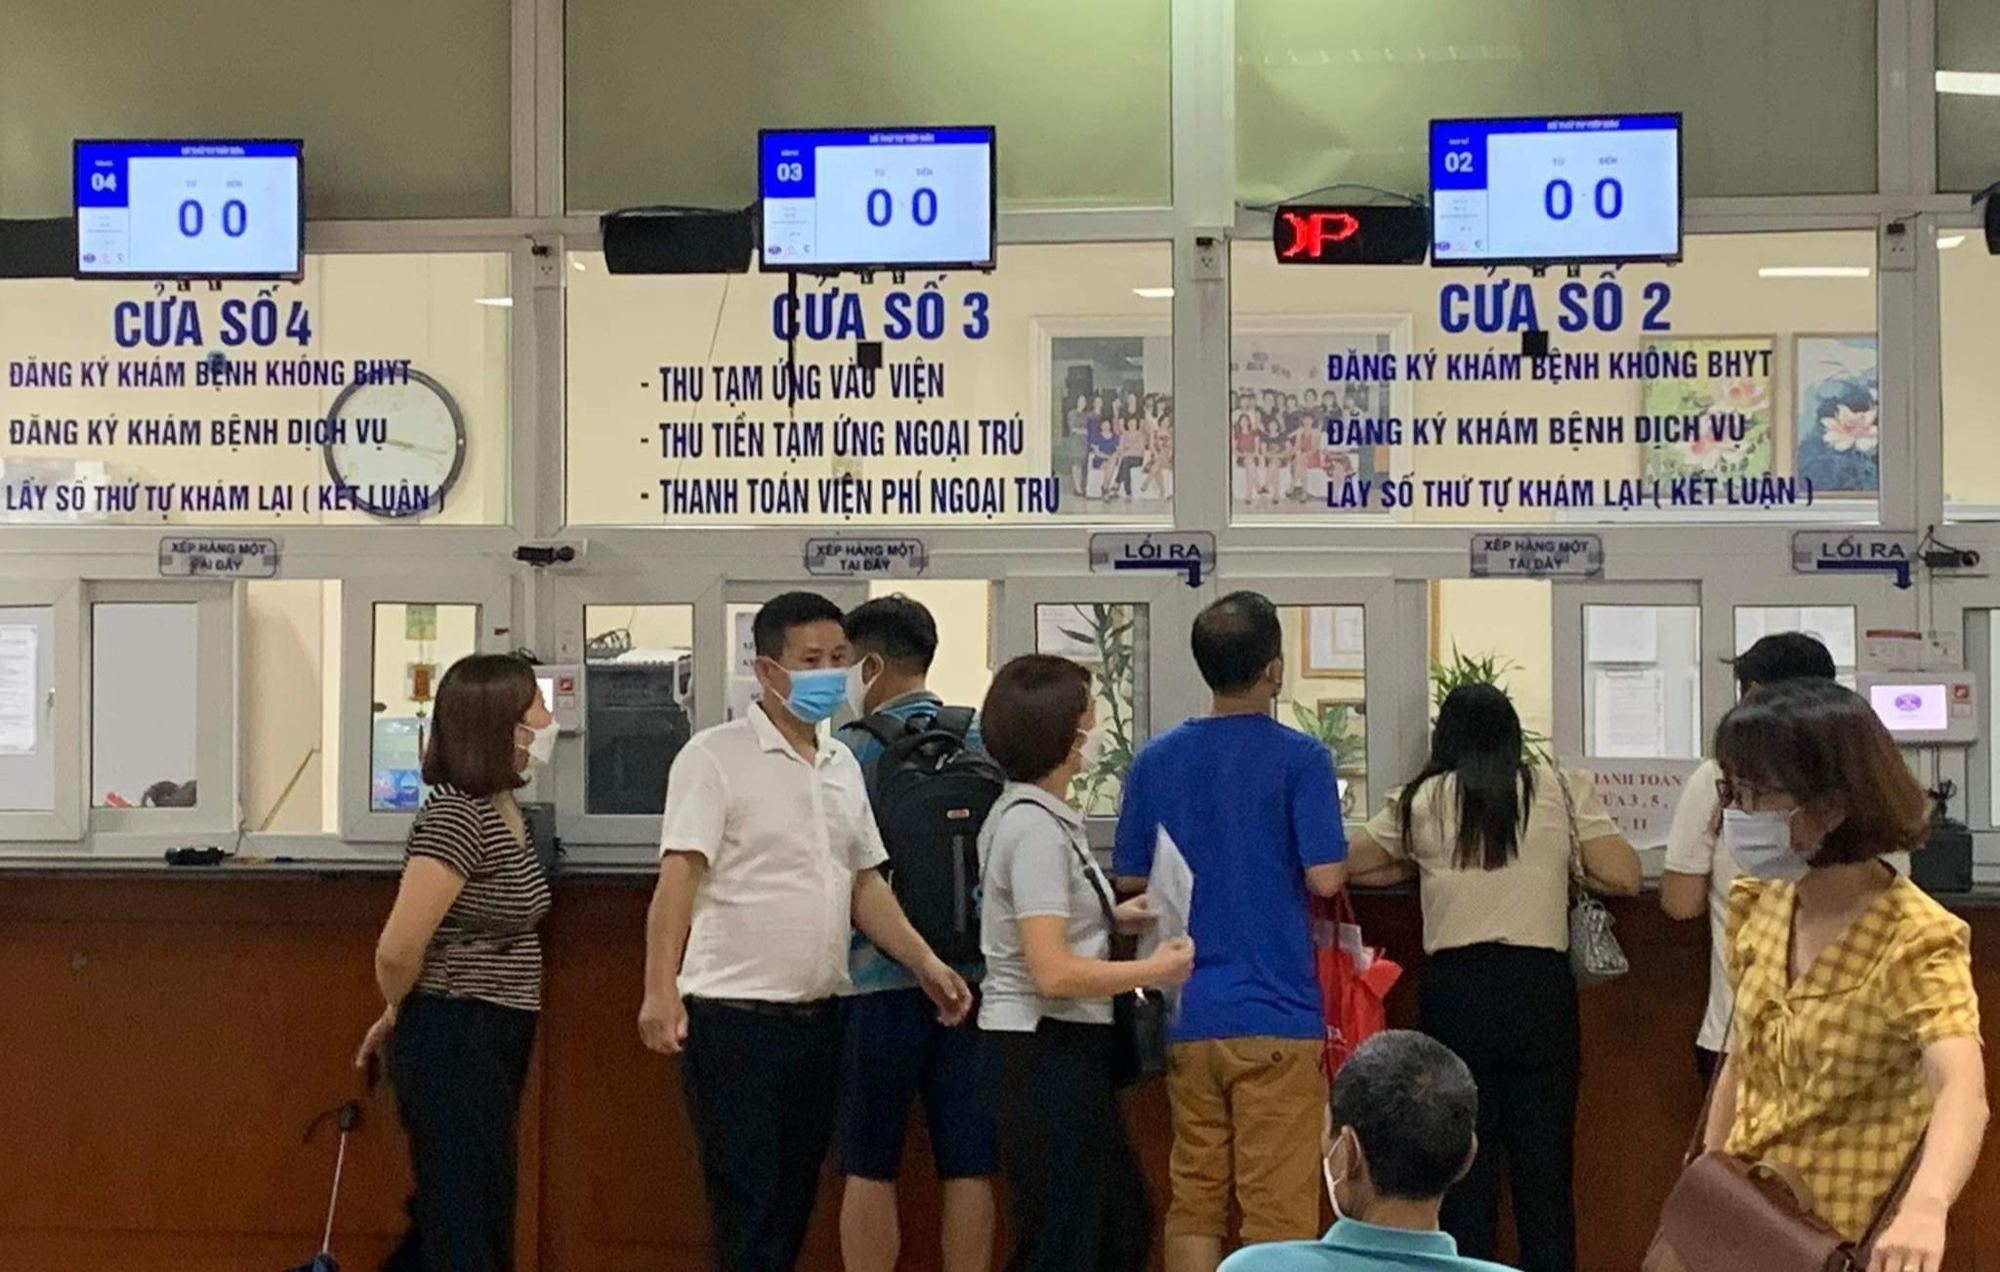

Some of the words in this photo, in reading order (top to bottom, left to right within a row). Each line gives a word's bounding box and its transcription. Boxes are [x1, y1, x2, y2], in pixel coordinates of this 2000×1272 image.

[777, 163, 802, 181] 03
[1444, 152, 1473, 172] 02
[91, 172, 117, 192] 04
[1545, 178, 1572, 220] 0
[1595, 178, 1622, 220] 0
[179, 200, 203, 237] 0
[222, 200, 247, 237] 0
[867, 189, 892, 226] 0
[912, 187, 937, 226] 0
[114, 282, 203, 347] CỬA
[220, 284, 281, 347] SỐ
[285, 300, 312, 346] 4
[773, 276, 867, 341] CỬA
[883, 274, 947, 341] SỐ
[963, 291, 991, 341] 3
[1440, 266, 1540, 333] CỬA
[1558, 264, 1624, 332] SỐ
[1642, 282, 1671, 331] 2
[9, 355, 72, 388] ĐĂNG
[81, 355, 109, 387] KÝ
[118, 355, 186, 388] KHÁM
[195, 355, 257, 392] BỆNH
[266, 354, 345, 386] KHÔNG
[353, 360, 411, 386] BHYT
[659, 366, 704, 402] THU
[712, 365, 764, 407] TẠM
[772, 357, 821, 401] ỨNG
[830, 357, 877, 400] VÀO
[889, 355, 944, 404] VIỆN
[1328, 348, 1397, 381] ĐĂNG
[1406, 347, 1438, 381] KÝ
[1447, 347, 1521, 381] KHÁM
[1531, 347, 1600, 385] BỆNH
[1609, 346, 1698, 379] KHÔNG
[1708, 351, 1773, 378] BHYT
[9, 413, 79, 446] ĐĂNG
[87, 412, 119, 446] KÝ
[128, 413, 202, 446] KHÁM
[211, 412, 278, 452] BỆNH
[288, 418, 347, 451] DỊCH
[356, 418, 387, 451] VỤ
[659, 422, 703, 458] THU
[712, 411, 765, 458] TIỀN
[773, 421, 824, 463] TẠM
[833, 413, 884, 457] ỨNG
[895, 420, 969, 463] NGOẠI
[978, 411, 1024, 456] TRÚ
[1327, 412, 1402, 446] ĐĂNG
[1413, 411, 1447, 445] KÝ
[1457, 411, 1538, 445] KHÁM
[1549, 410, 1624, 451] BỆNH
[1634, 414, 1700, 449] DỊCH
[1710, 414, 1746, 449] VỤ
[6, 476, 48, 511] LẤY
[56, 475, 87, 511] SỐ
[94, 477, 140, 512] THỨ
[145, 482, 176, 520] TỰ
[181, 479, 249, 512] KHÁM
[258, 485, 293, 517] LẠI
[319, 475, 361, 511] KẾT
[369, 478, 430, 515] LUẬN
[659, 478, 738, 514] THANH
[747, 471, 809, 514] TOÁN
[818, 472, 872, 521] VIỆN
[882, 470, 922, 514] PHÍ
[930, 477, 1005, 520] NGOẠI
[1015, 471, 1060, 514] TRÚ
[1326, 472, 1371, 508] LẤY
[1381, 471, 1415, 508] SỐ
[1422, 474, 1474, 508] THỨ
[1478, 476, 1513, 513] TỰ
[1518, 474, 1594, 508] KHÁM
[1604, 478, 1643, 511] LẠI
[1671, 472, 1718, 506] KẾT
[1727, 471, 1796, 509] LUẬN
[239, 542, 266, 556] MỘT
[887, 543, 915, 558] MỘT
[1124, 533, 1162, 558] LỐI
[1169, 543, 1200, 558] RA
[1558, 540, 1588, 554] MỘT
[1821, 535, 1862, 558] LỐI
[1871, 543, 1904, 558] RA
[1594, 773, 1634, 785] ANH
